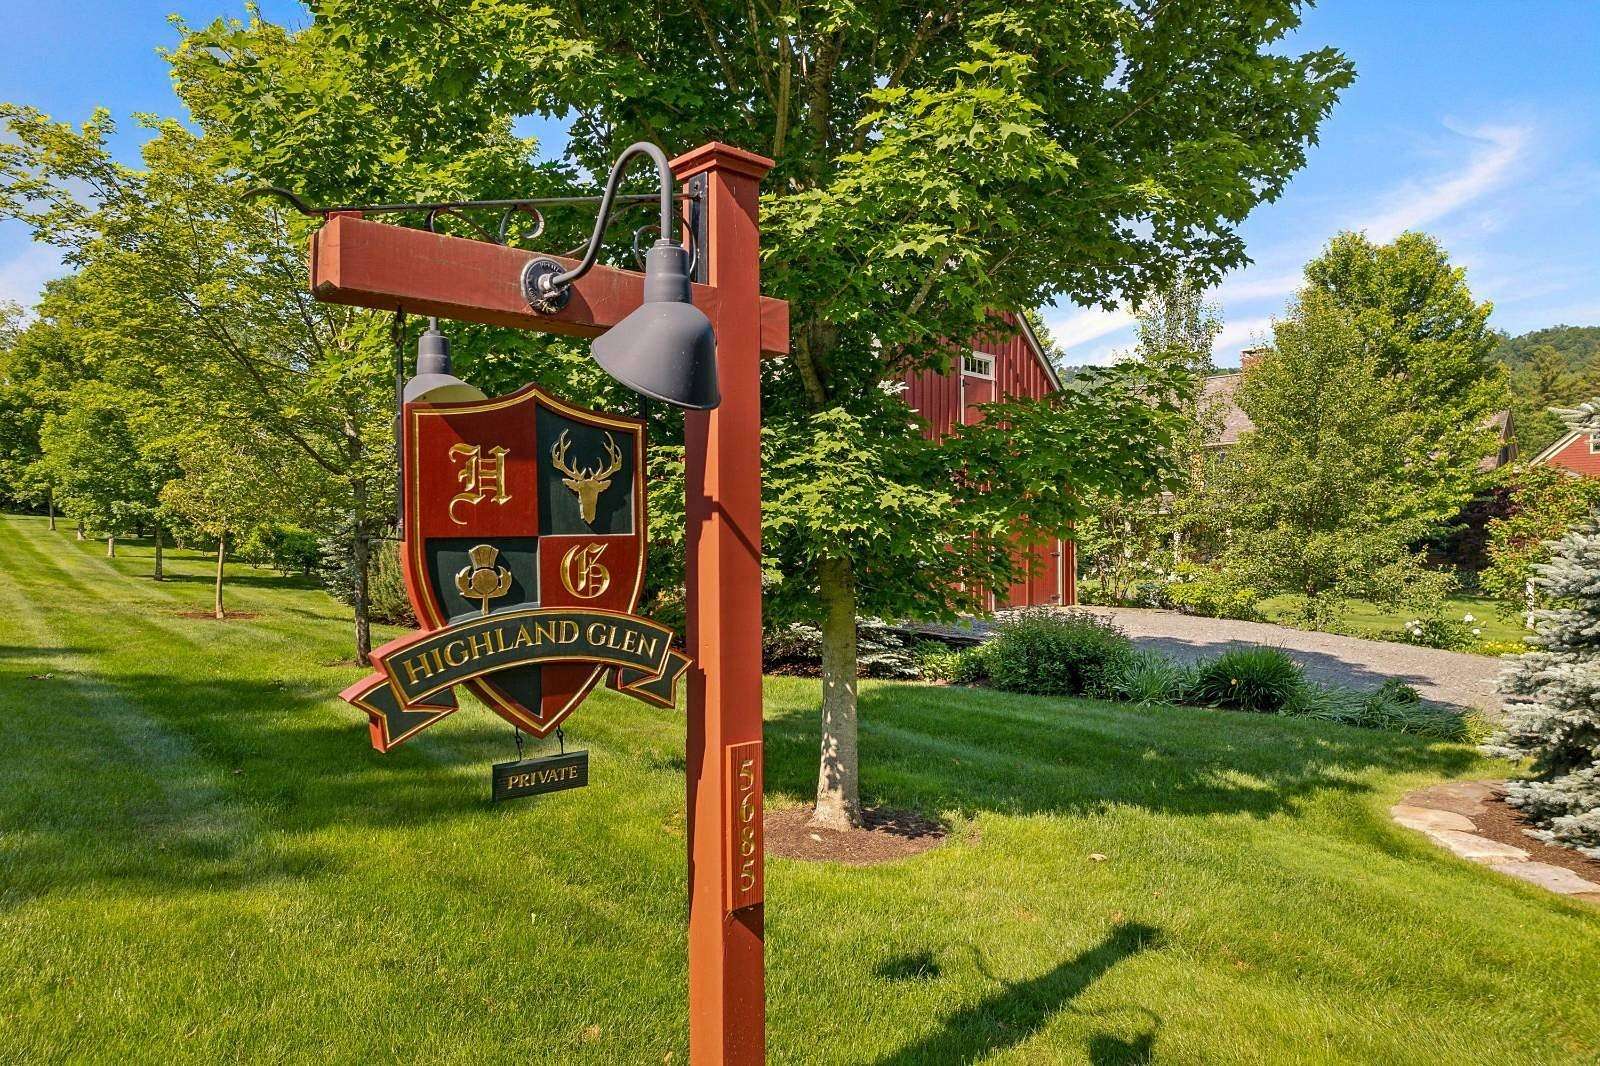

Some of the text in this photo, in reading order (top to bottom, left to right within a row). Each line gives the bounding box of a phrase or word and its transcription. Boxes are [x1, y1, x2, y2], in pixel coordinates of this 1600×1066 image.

[449, 443, 512, 525] H
[560, 543, 611, 599] G
[402, 620, 658, 685] HIGHLAND GLEN
[507, 765, 578, 790] PRIVATE
[739, 759, 755, 892] 5685
